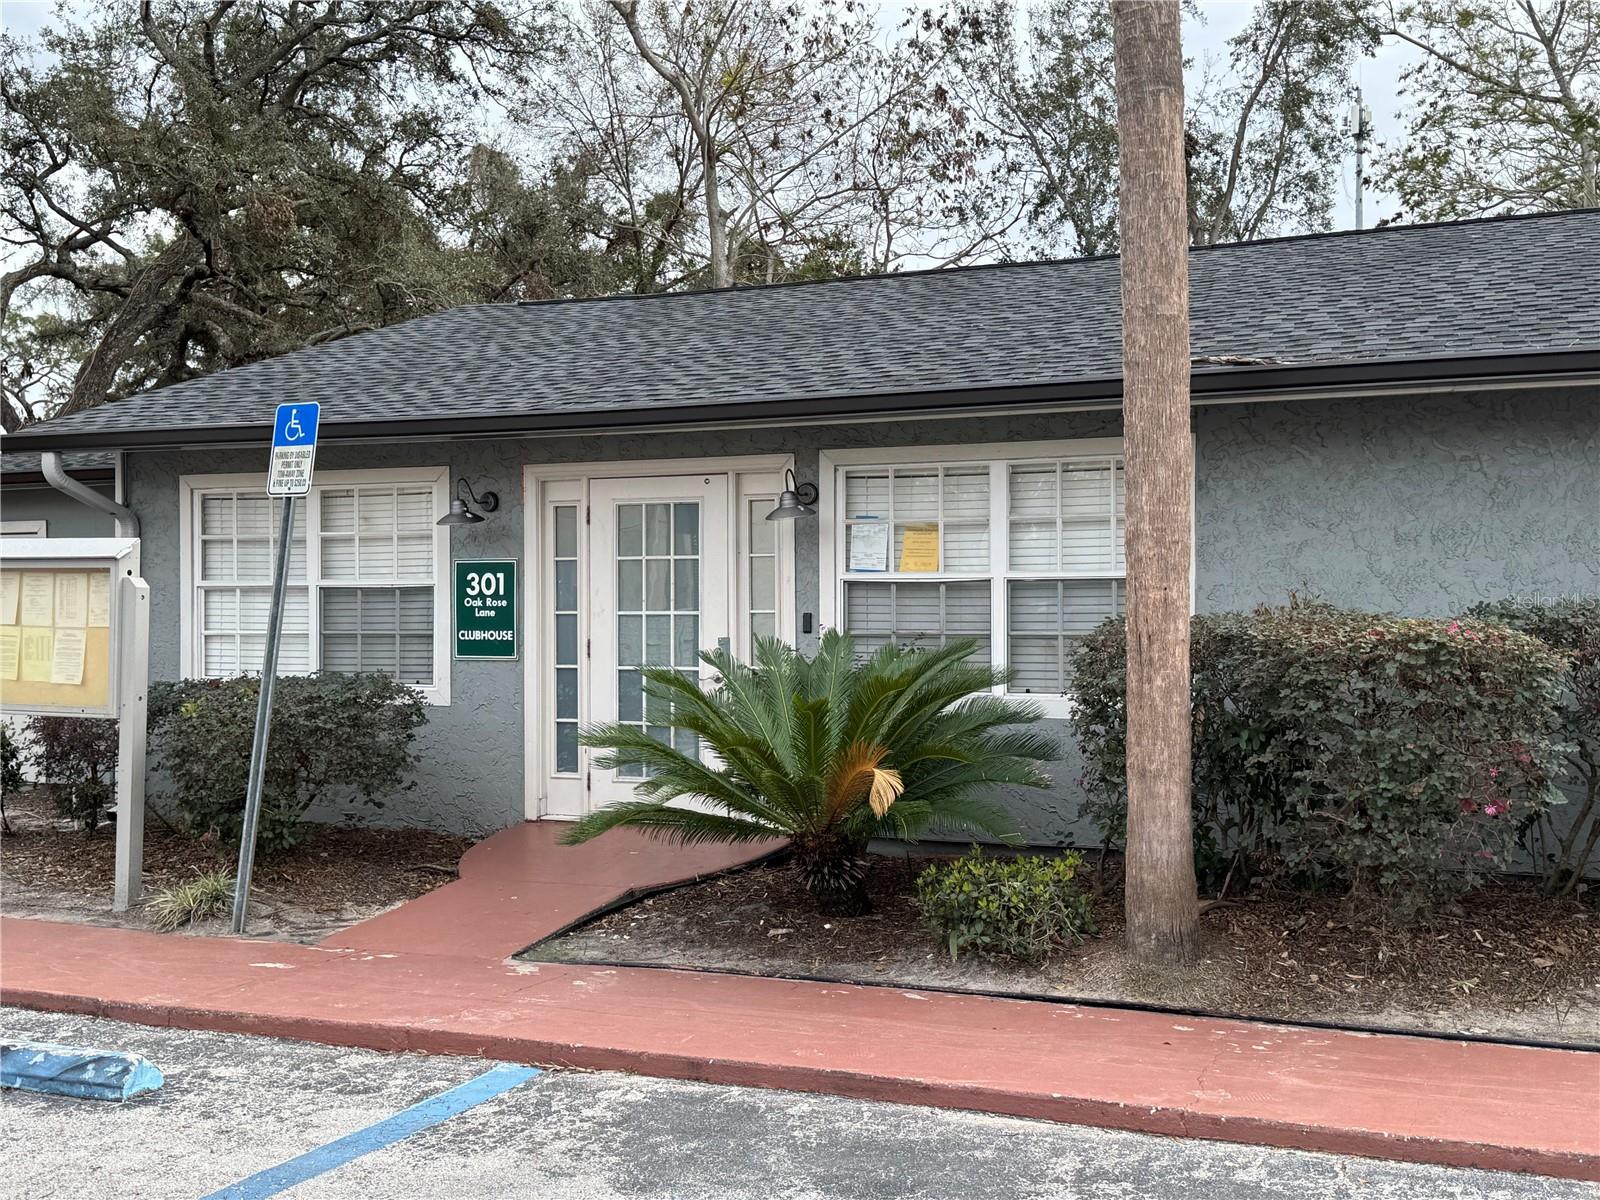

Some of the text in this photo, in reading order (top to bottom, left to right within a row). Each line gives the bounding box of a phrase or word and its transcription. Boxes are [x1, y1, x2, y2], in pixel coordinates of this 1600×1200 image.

[281, 460, 303, 469] PERMIT ONLY
[296, 469, 304, 477] ZONE
[284, 479, 289, 487] UP
[466, 572, 505, 596] 301
[464, 597, 508, 607] Oak Rose
[475, 608, 496, 617] Lane
[458, 630, 513, 641] CLUBHOUSE
